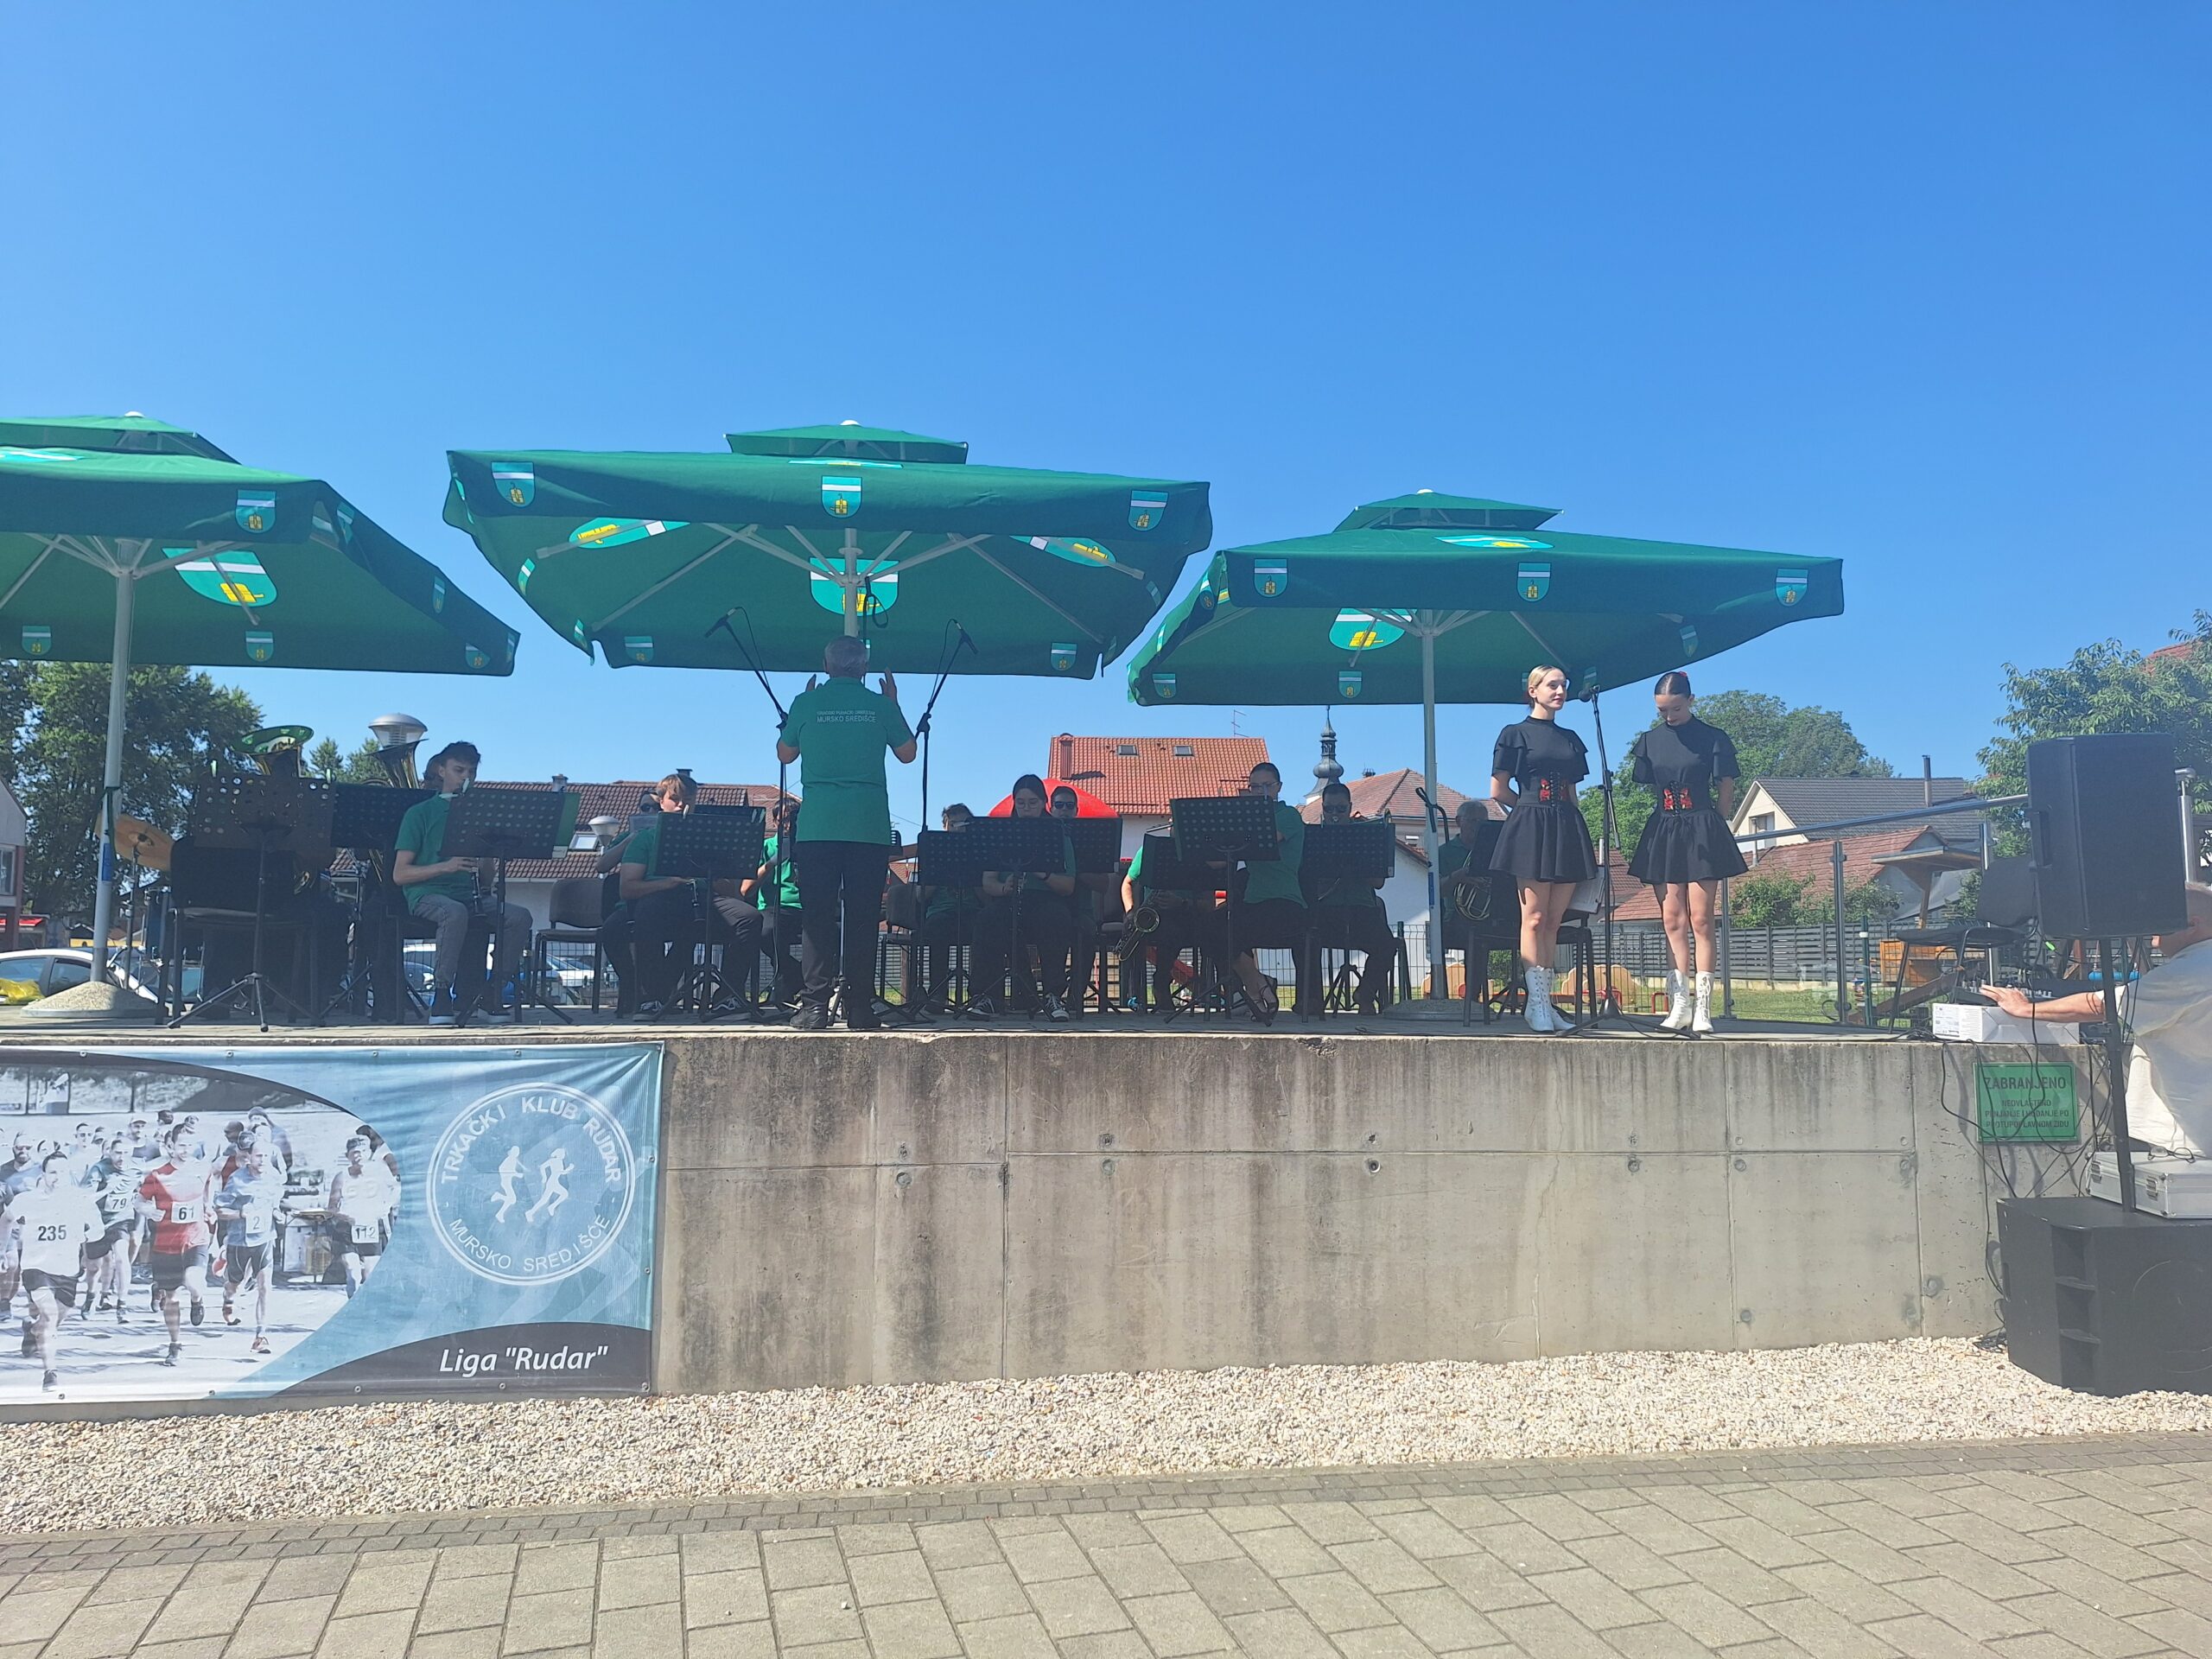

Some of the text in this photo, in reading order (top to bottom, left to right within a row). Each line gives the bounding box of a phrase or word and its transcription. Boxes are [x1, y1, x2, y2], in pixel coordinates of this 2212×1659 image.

[1984, 1077, 2067, 1090] ZABRANJENO
[1986, 1120, 2053, 1128] POTUPOLAVNOM
[442, 1096, 622, 1185] TRKAČKI KLUB RUDAR
[111, 1198, 128, 1210] 79
[178, 1206, 194, 1221] 61
[37, 1224, 67, 1242] 235
[354, 1227, 377, 1240] 112
[449, 1218, 512, 1270] MURSKO
[439, 1345, 609, 1378] Liga "Rudar"
